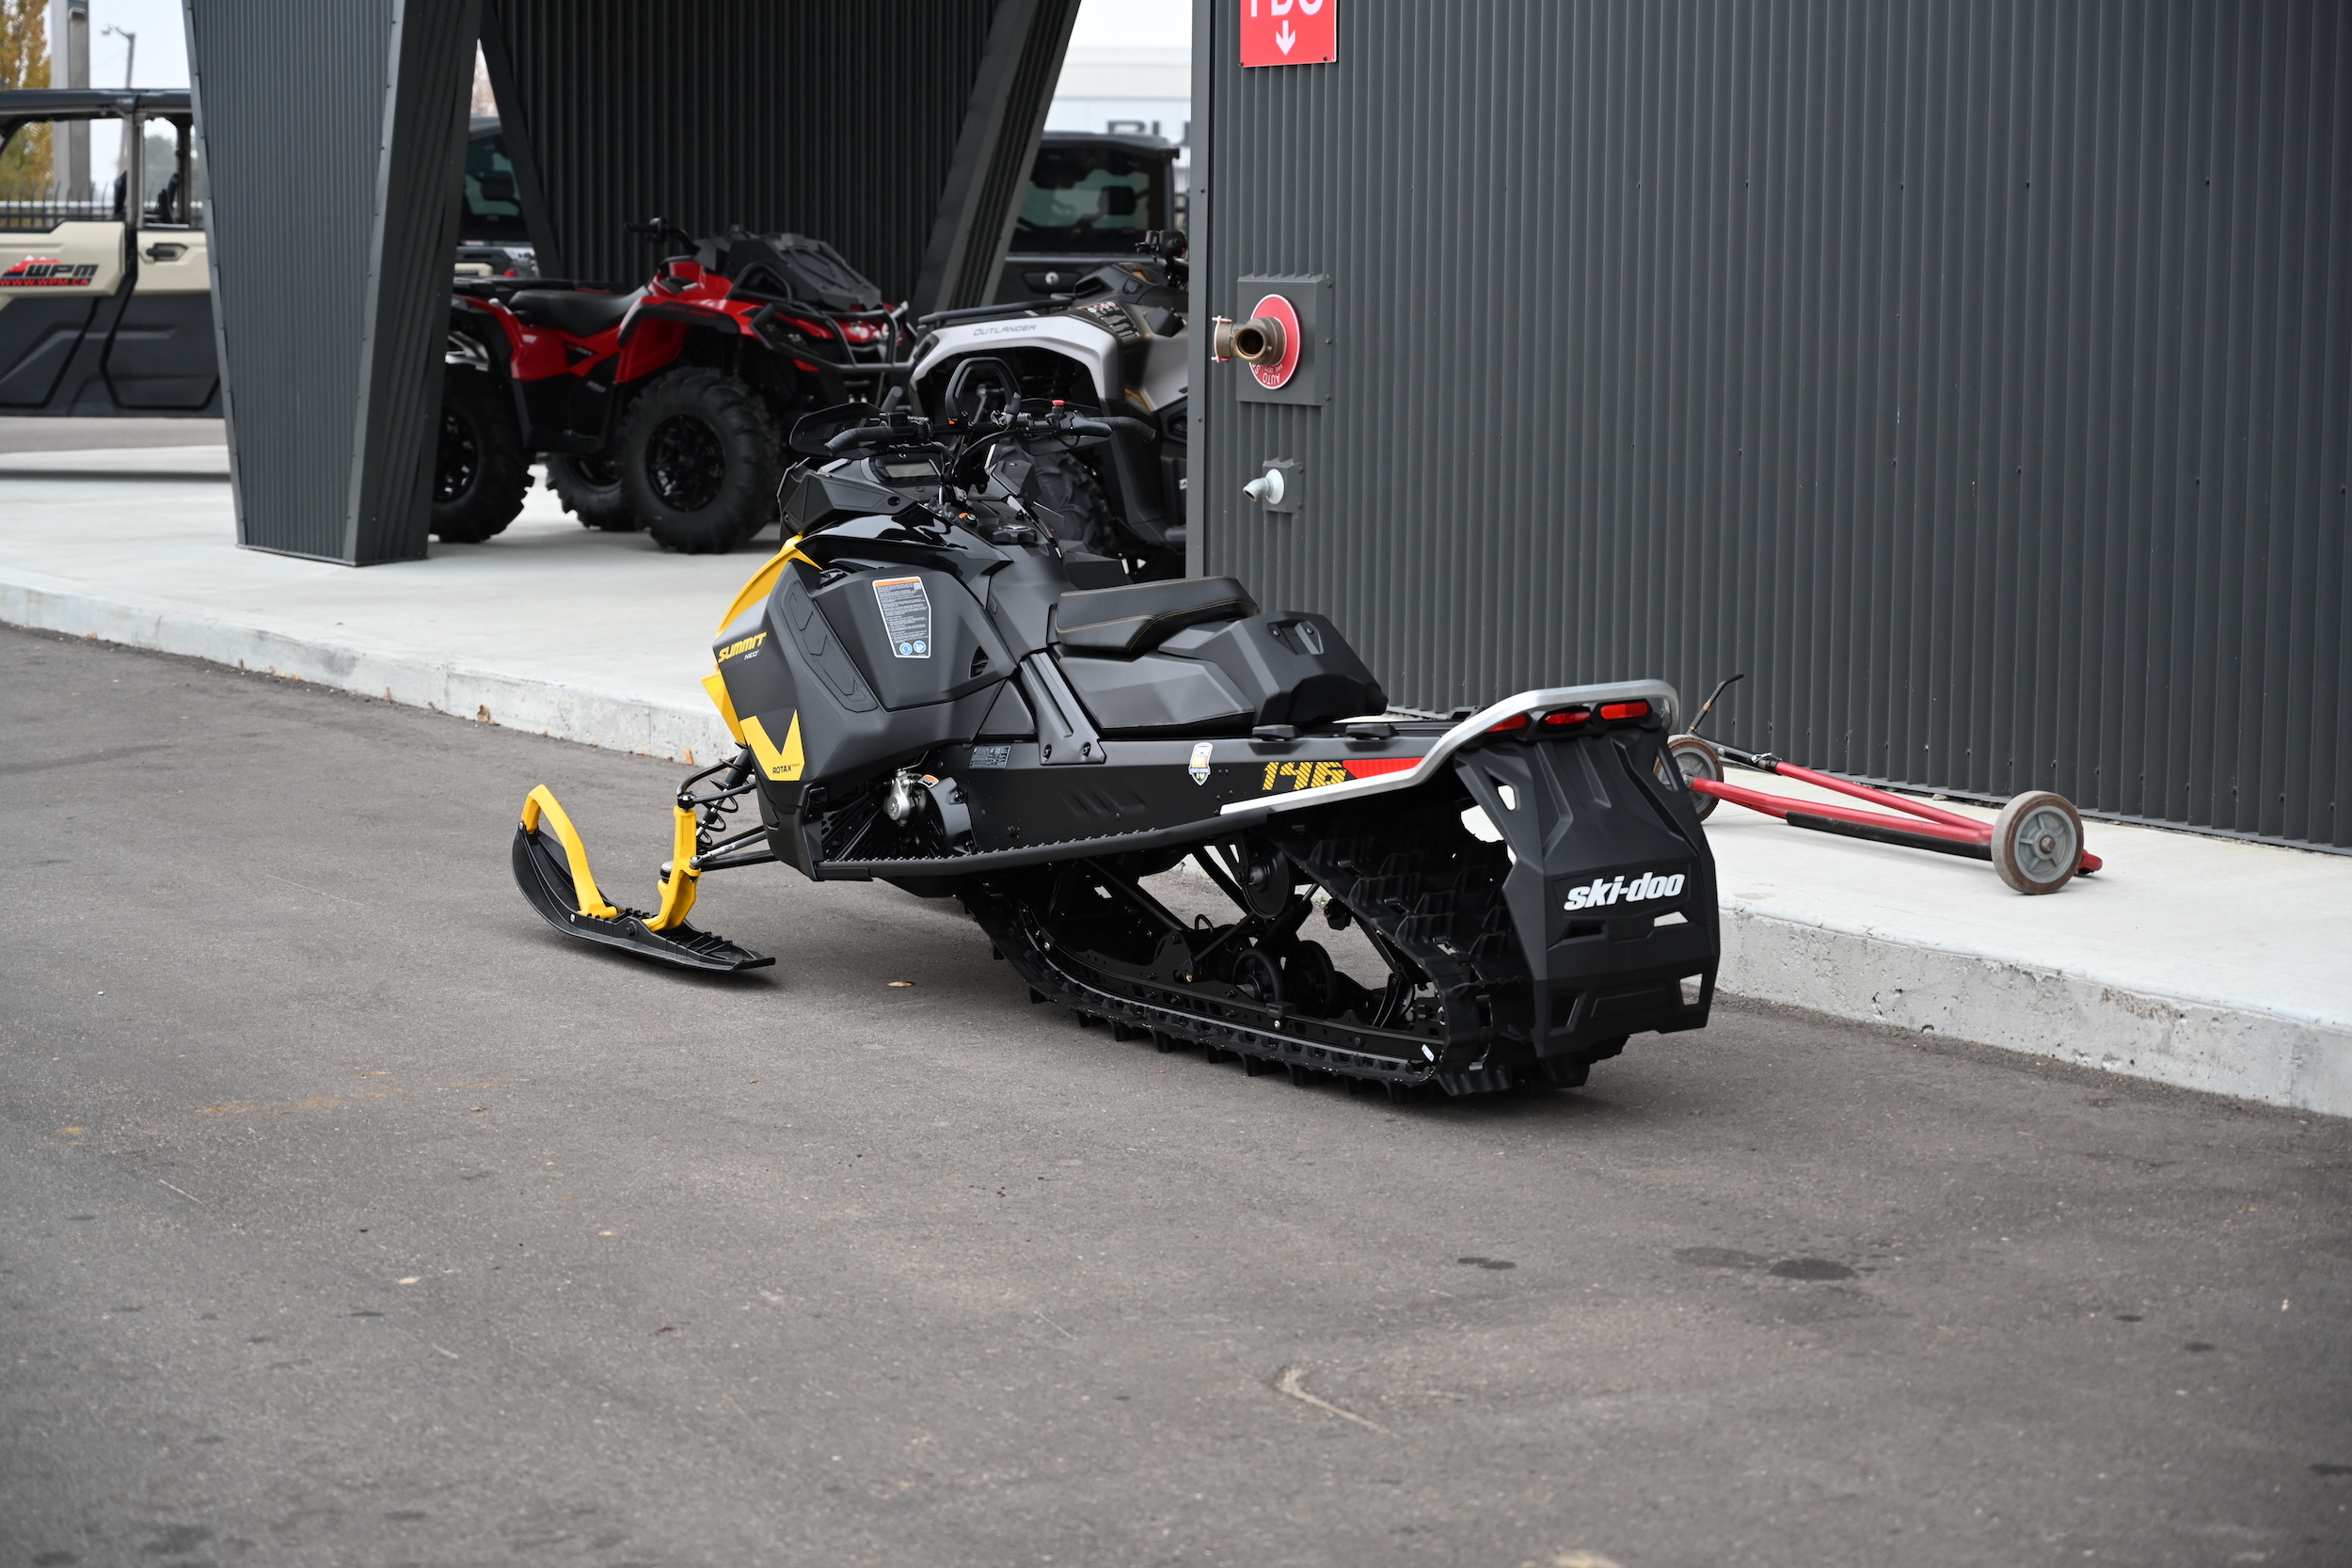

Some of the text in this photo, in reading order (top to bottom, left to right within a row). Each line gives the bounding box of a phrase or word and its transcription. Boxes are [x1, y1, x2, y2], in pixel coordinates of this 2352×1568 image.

[24, 264, 99, 277] WPM
[973, 324, 1037, 336] OUTLANDER
[1262, 372, 1280, 385] AUTO
[718, 631, 767, 663] SUMMIT
[771, 764, 792, 774] ROTAX
[1262, 761, 1347, 790] 146
[1563, 872, 1685, 911] ski-doo
